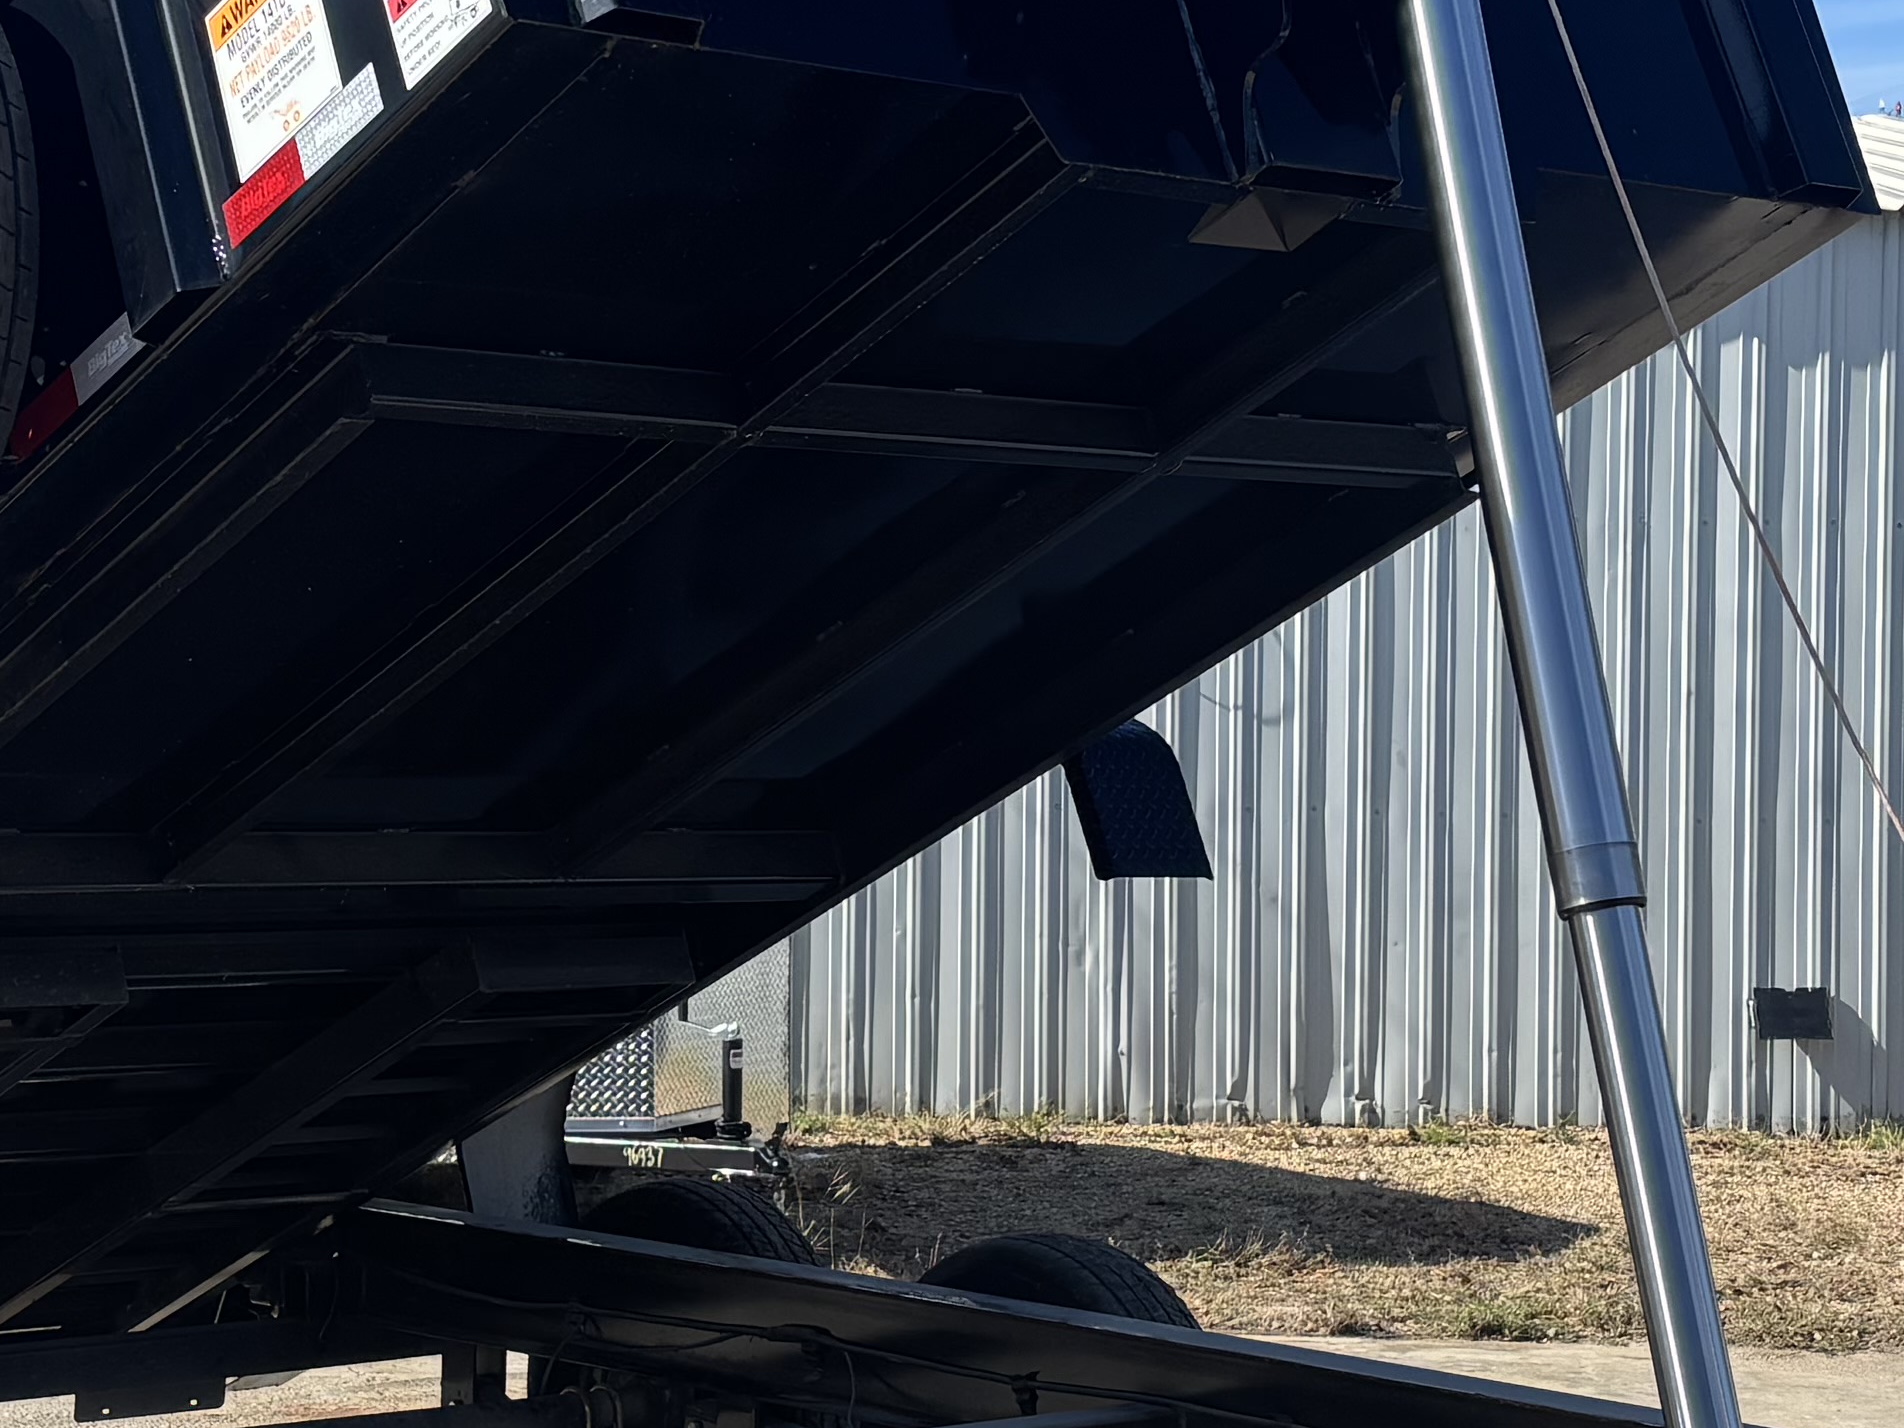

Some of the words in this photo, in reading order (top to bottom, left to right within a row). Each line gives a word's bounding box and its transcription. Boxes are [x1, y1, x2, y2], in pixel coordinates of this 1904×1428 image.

[226, 17, 261, 61] MODEL
[266, 30, 314, 83] DISTRIBUTED
[87, 330, 129, 379] BigTex
